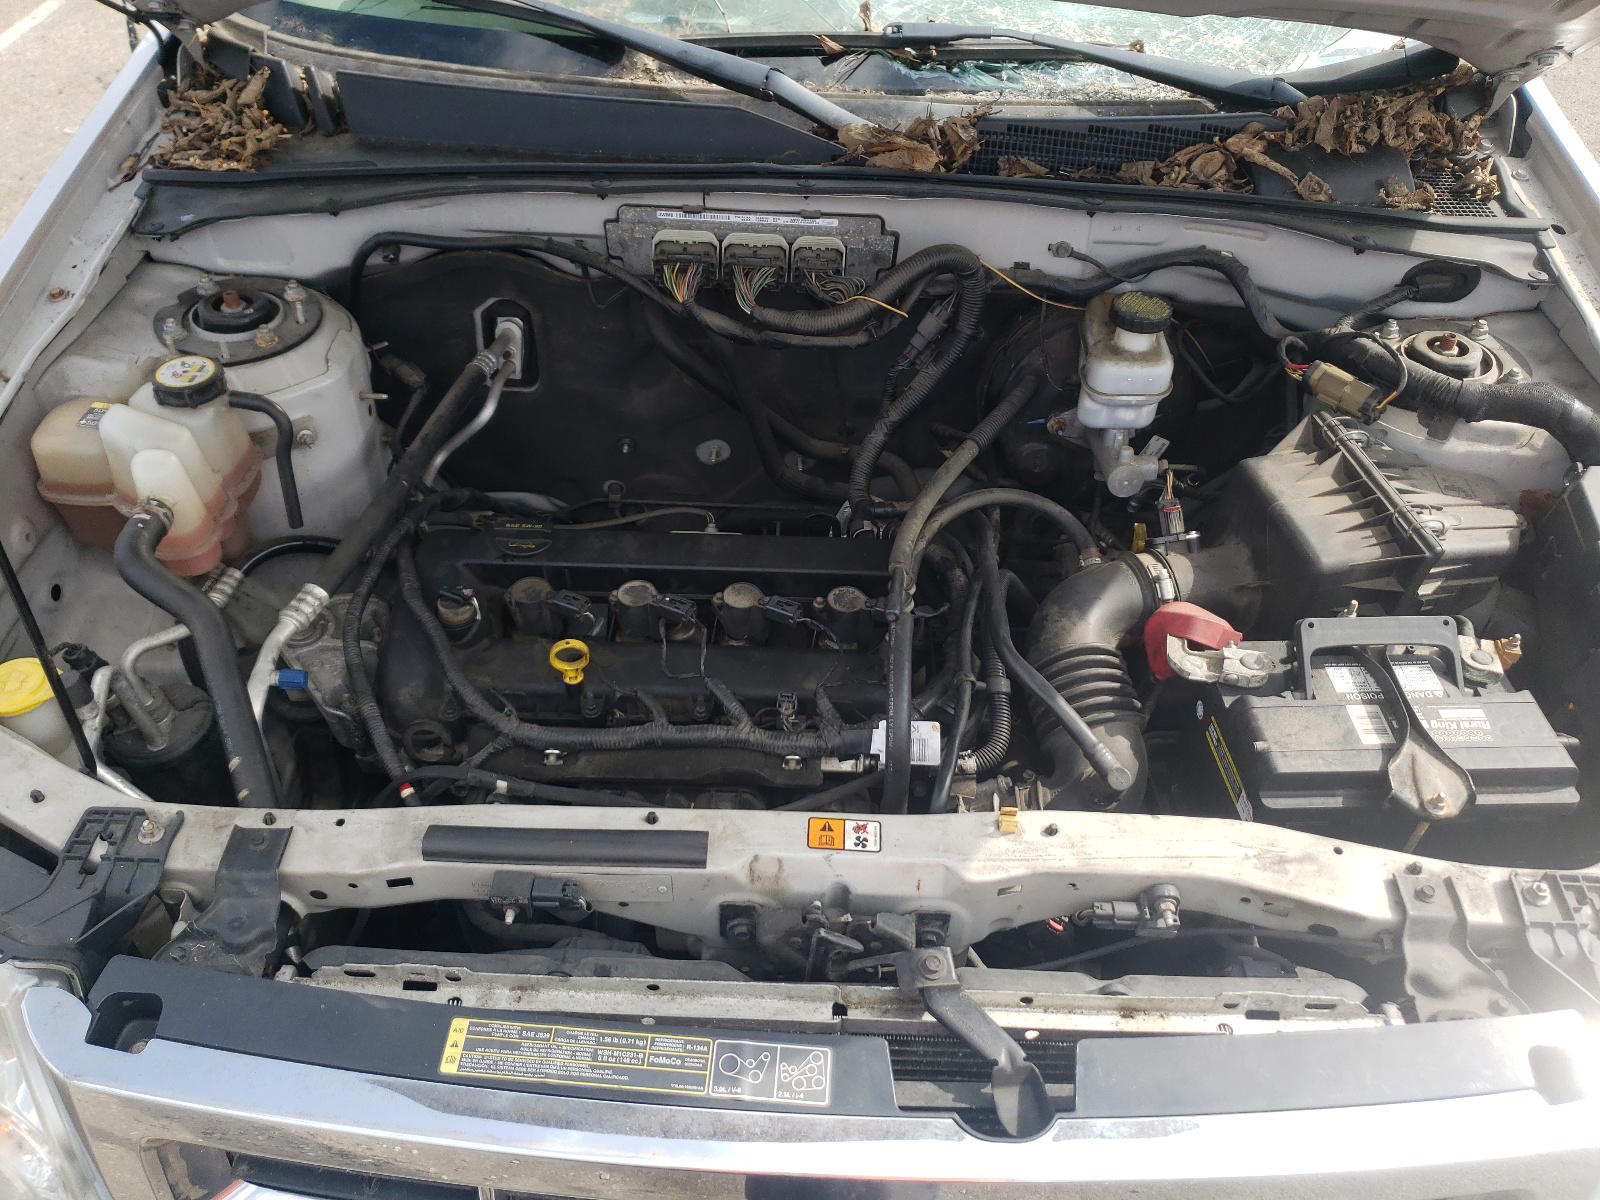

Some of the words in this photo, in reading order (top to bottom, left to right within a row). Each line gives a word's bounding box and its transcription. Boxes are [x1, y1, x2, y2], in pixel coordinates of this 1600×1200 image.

[1345, 692, 1385, 701] POISON
[1430, 720, 1457, 731] King
[1461, 720, 1491, 730] Rural
[521, 1030, 535, 1038] SAE
[686, 1044, 708, 1052] R-134A
[649, 1055, 682, 1065] FoMoCo
